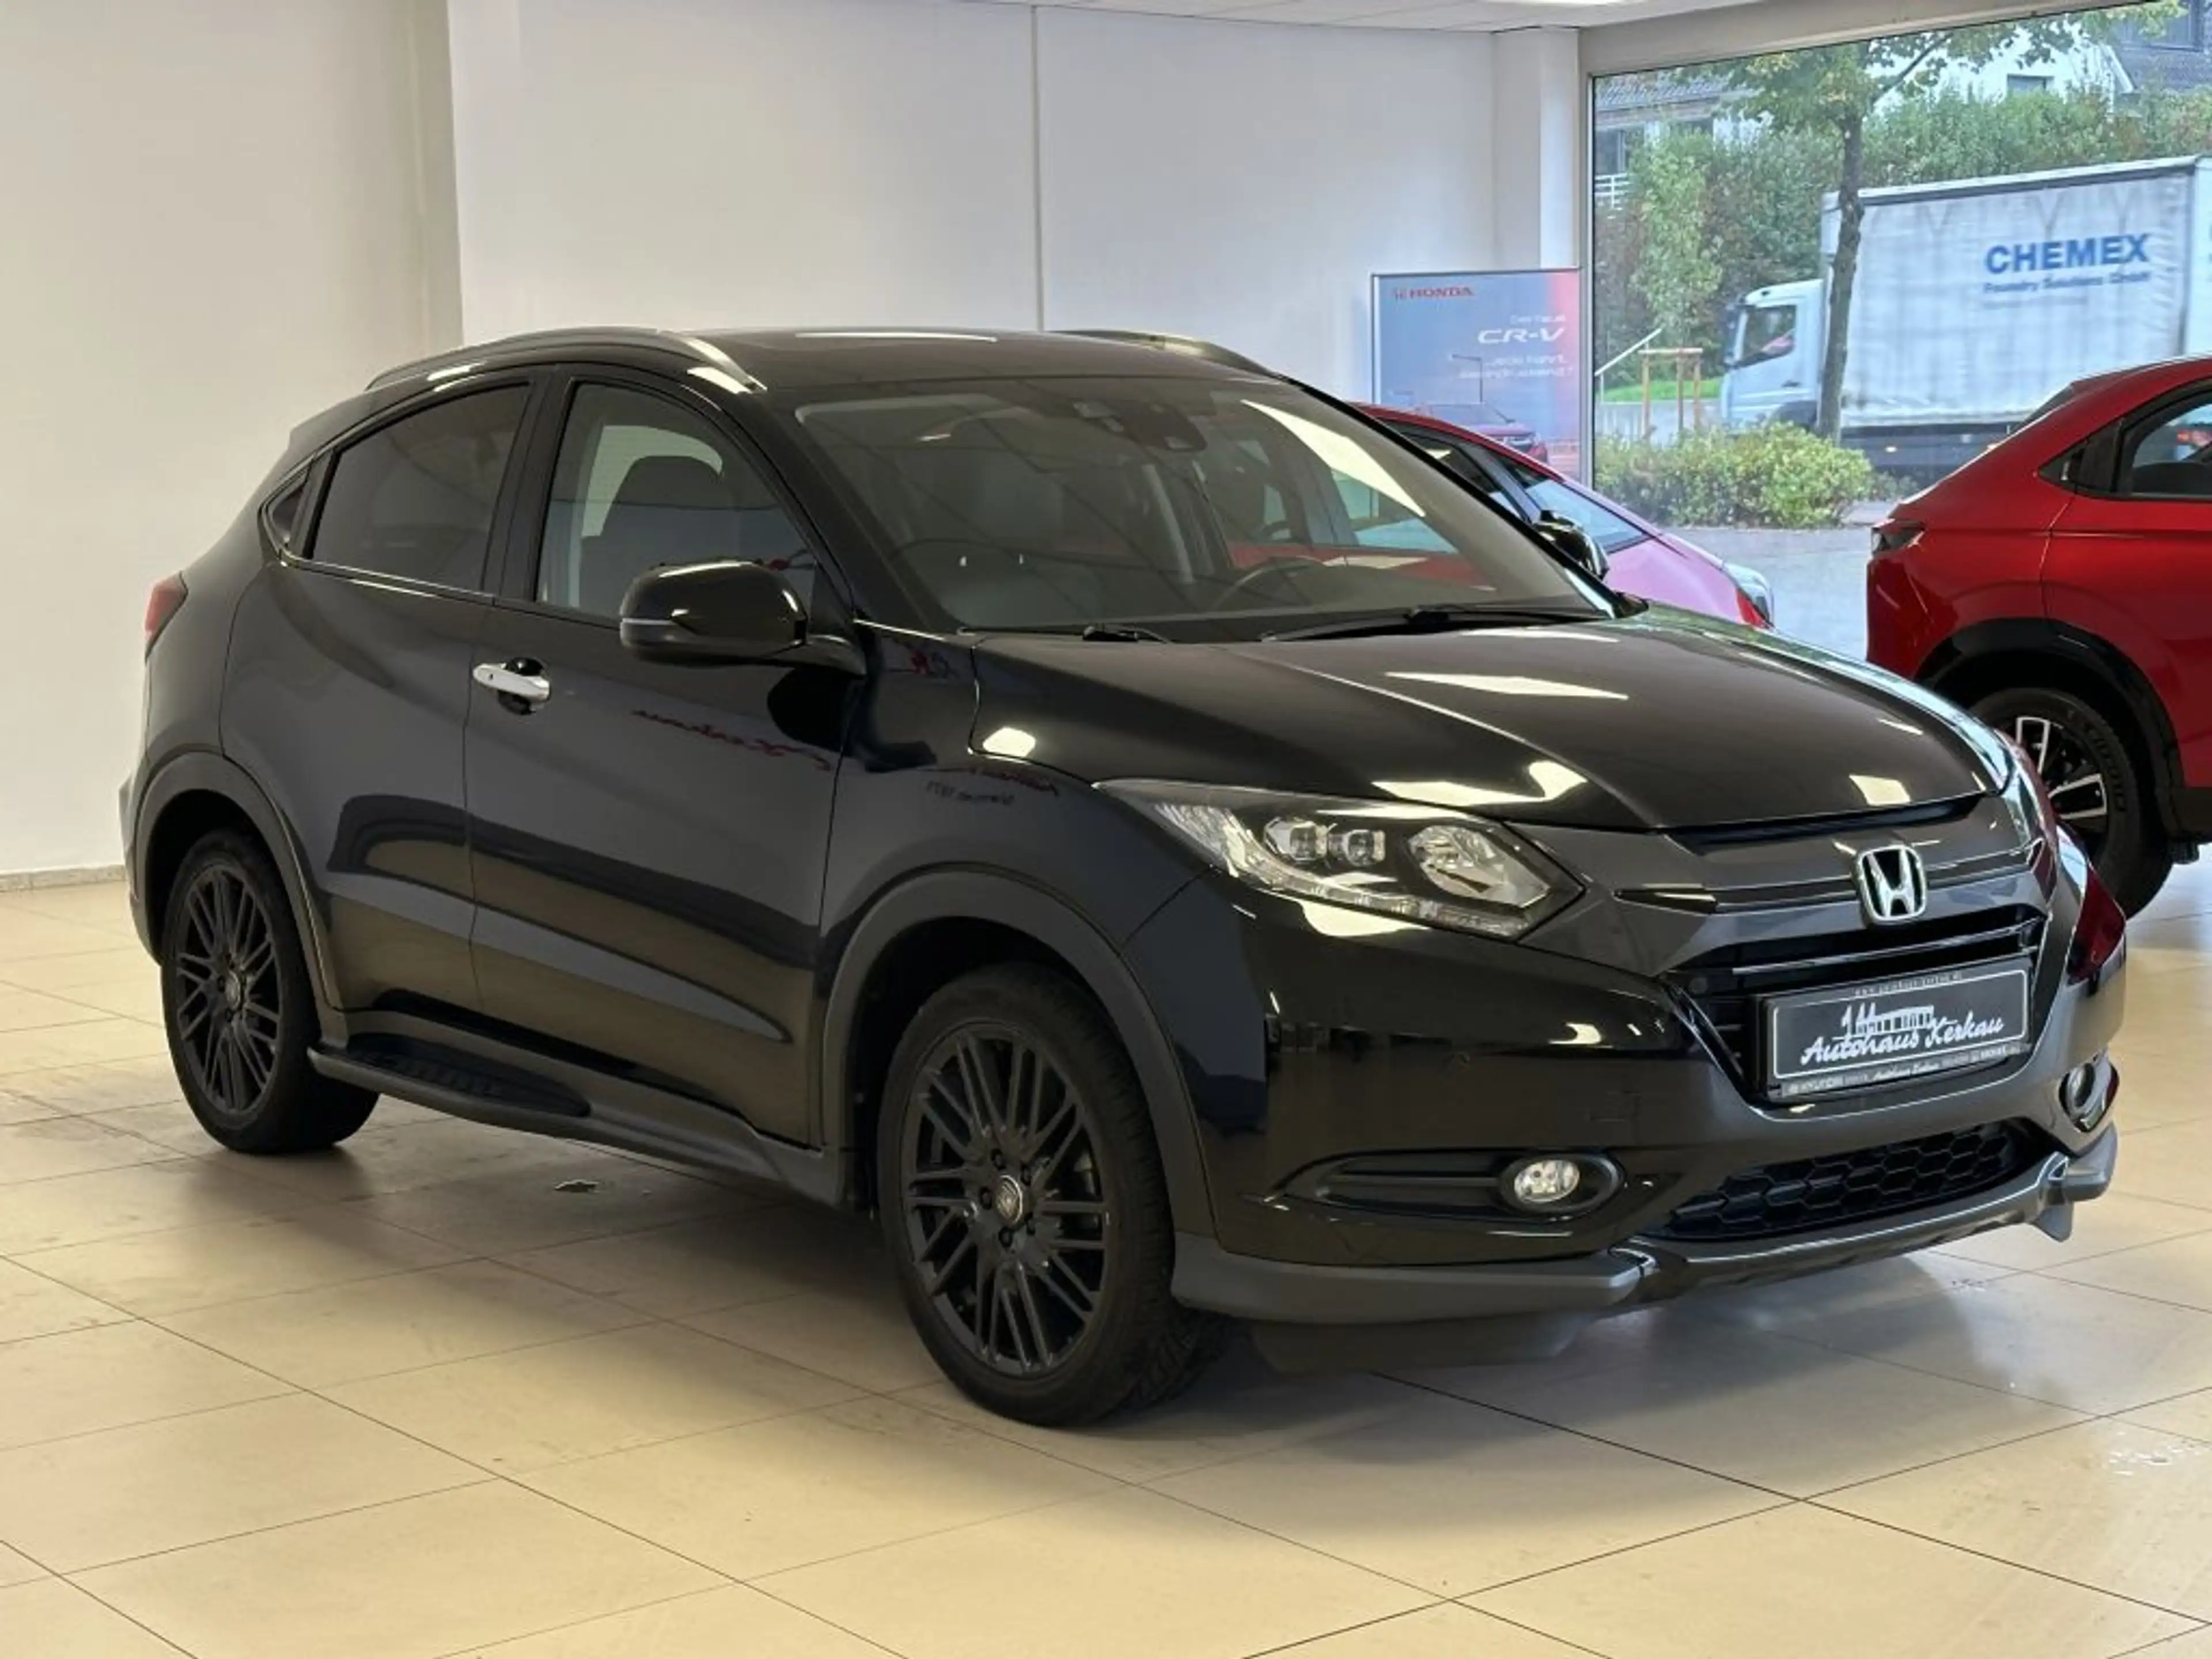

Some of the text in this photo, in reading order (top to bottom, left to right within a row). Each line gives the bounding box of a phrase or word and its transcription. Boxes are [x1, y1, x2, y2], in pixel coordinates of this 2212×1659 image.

[1986, 233, 2150, 275] CHEMEX
[1409, 286, 1476, 300] HONDA
[1477, 327, 1565, 344] CR-V
[1800, 1029, 1919, 1066] Autohaus
[1924, 1010, 2004, 1049] Kerkau
